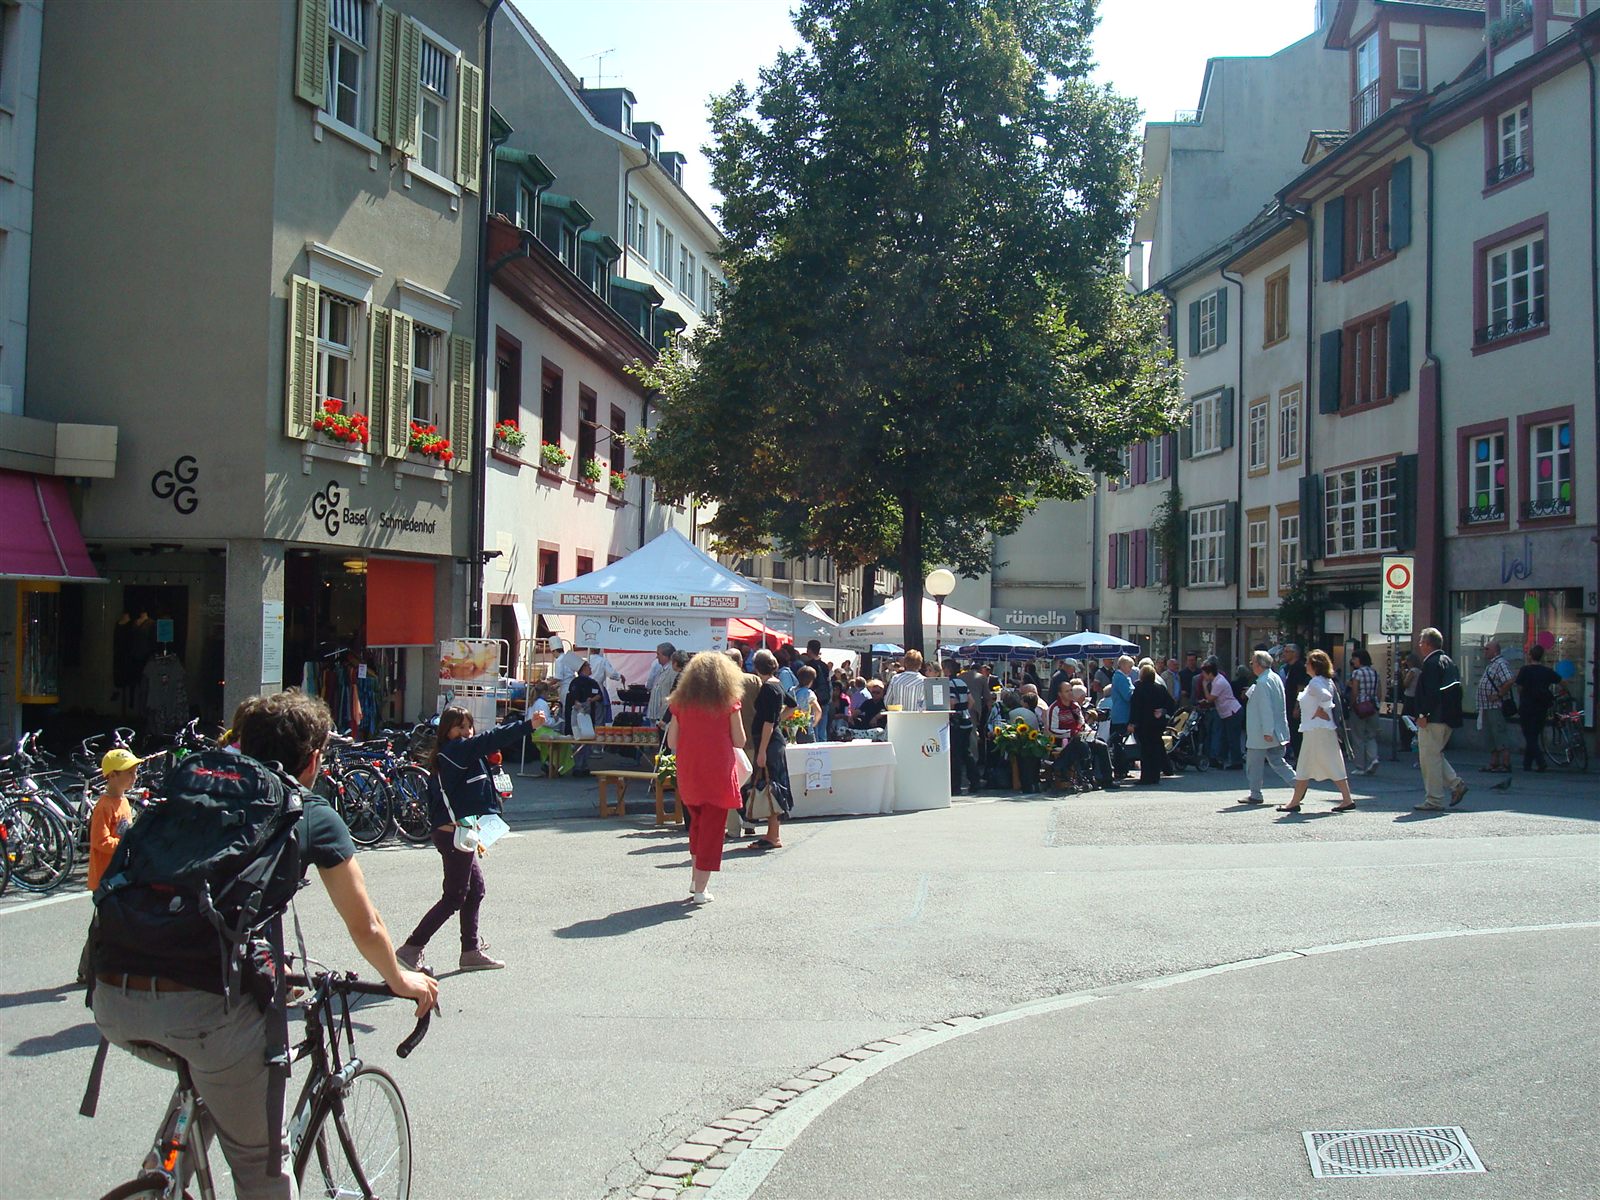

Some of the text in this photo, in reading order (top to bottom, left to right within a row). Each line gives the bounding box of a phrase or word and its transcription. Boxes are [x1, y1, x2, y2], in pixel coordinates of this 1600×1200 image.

[342, 507, 368, 526] Basel
[380, 512, 437, 535] Schmiedenhof
[564, 594, 580, 603] MS
[694, 597, 710, 606] MS
[609, 615, 676, 627] Die Gilde kocht
[608, 624, 691, 637] für eine gute Sache.
